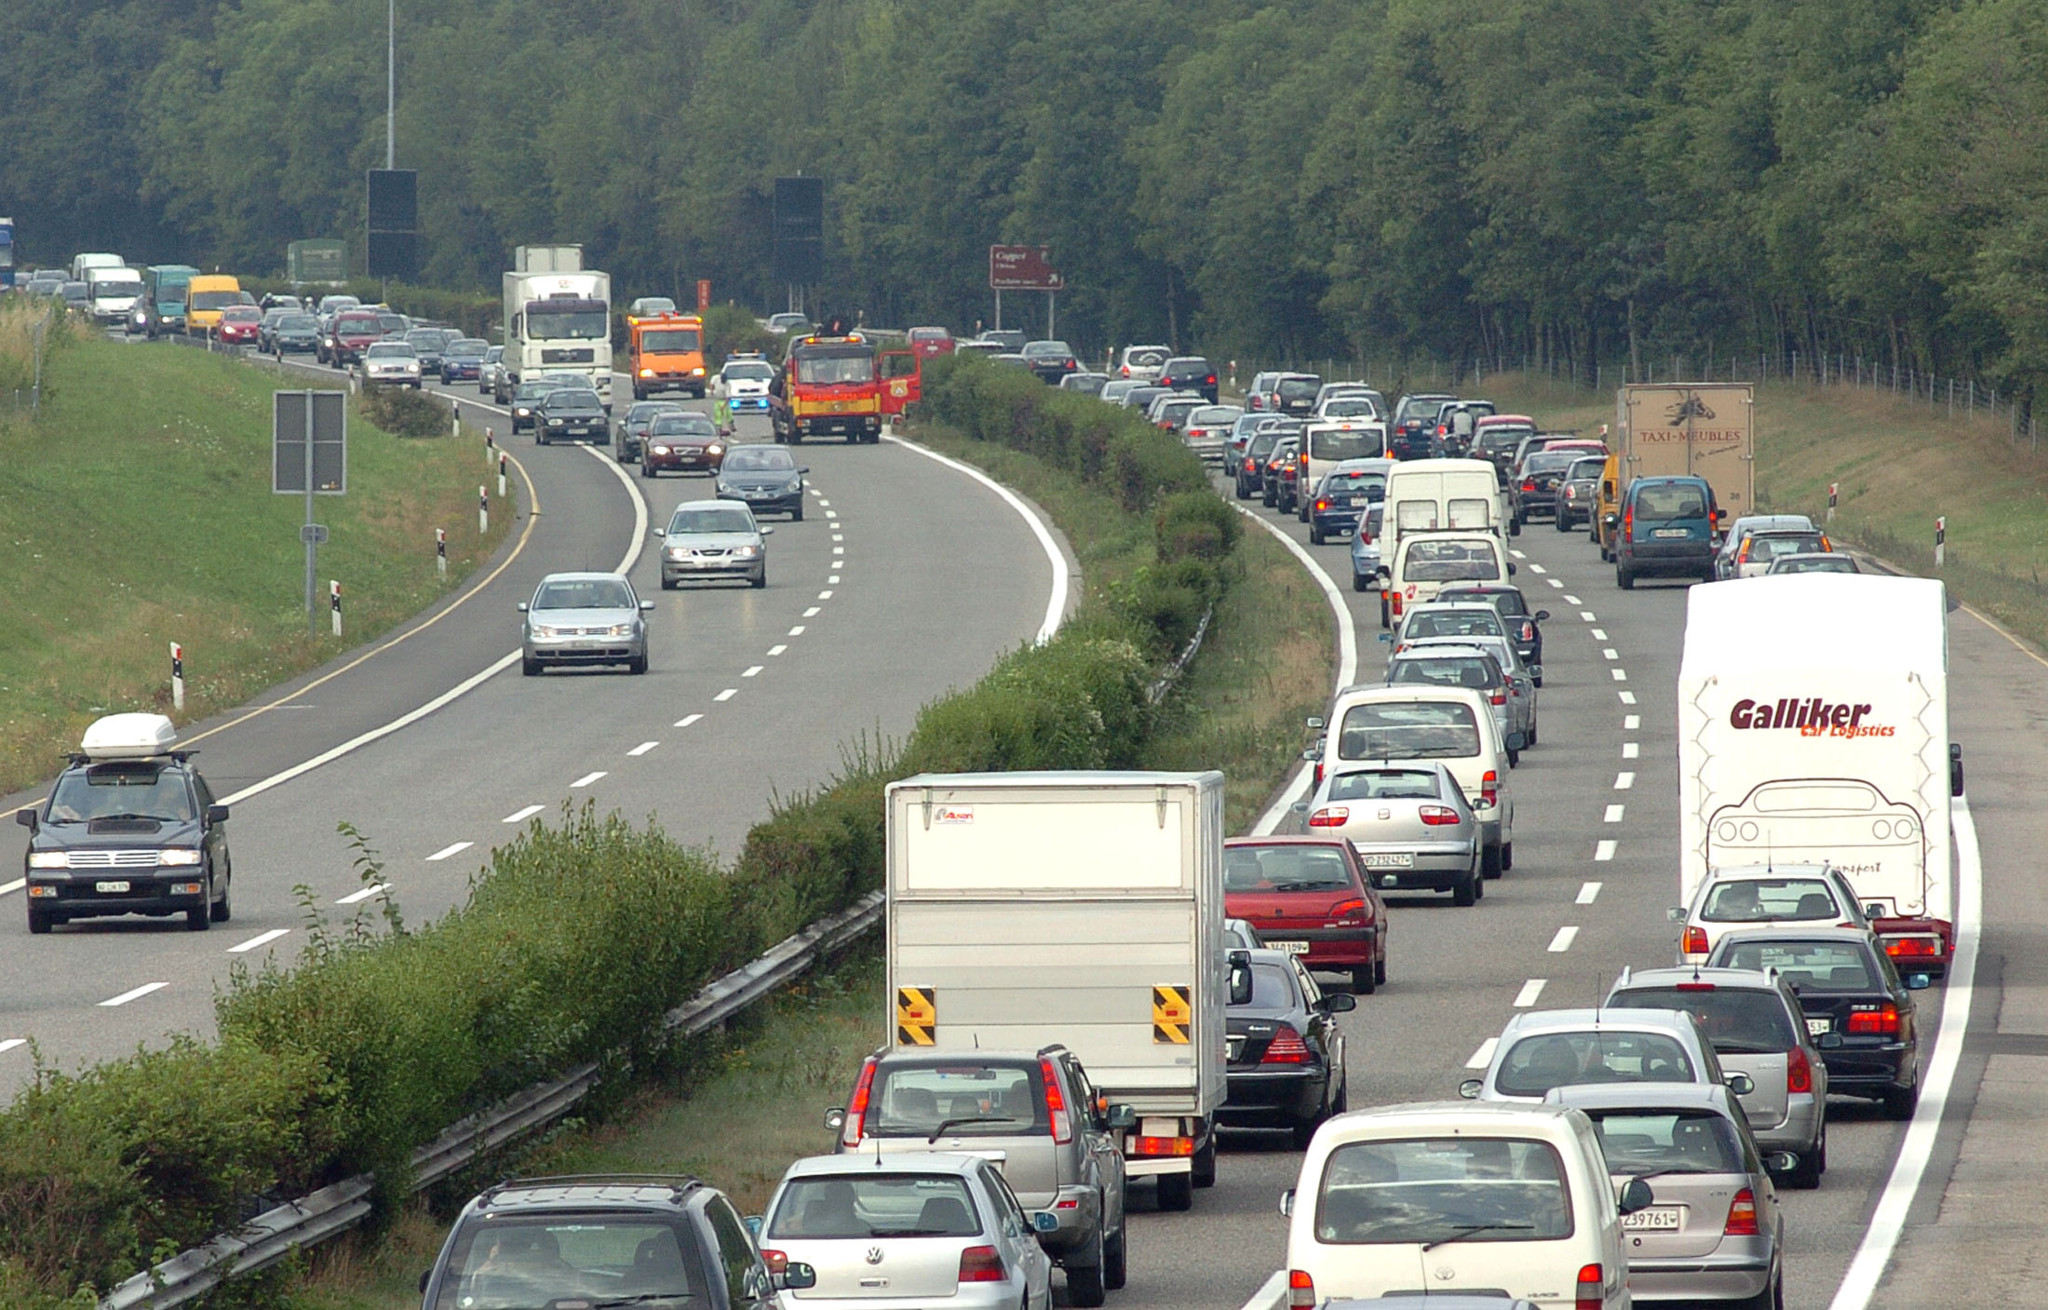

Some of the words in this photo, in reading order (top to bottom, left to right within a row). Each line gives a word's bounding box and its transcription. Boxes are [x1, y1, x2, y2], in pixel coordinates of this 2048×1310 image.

[1730, 697, 1872, 730] Galliker
[1800, 723, 1827, 737] Car
[1829, 723, 1896, 739] Logistics
[1623, 1213, 1669, 1226] 239761
